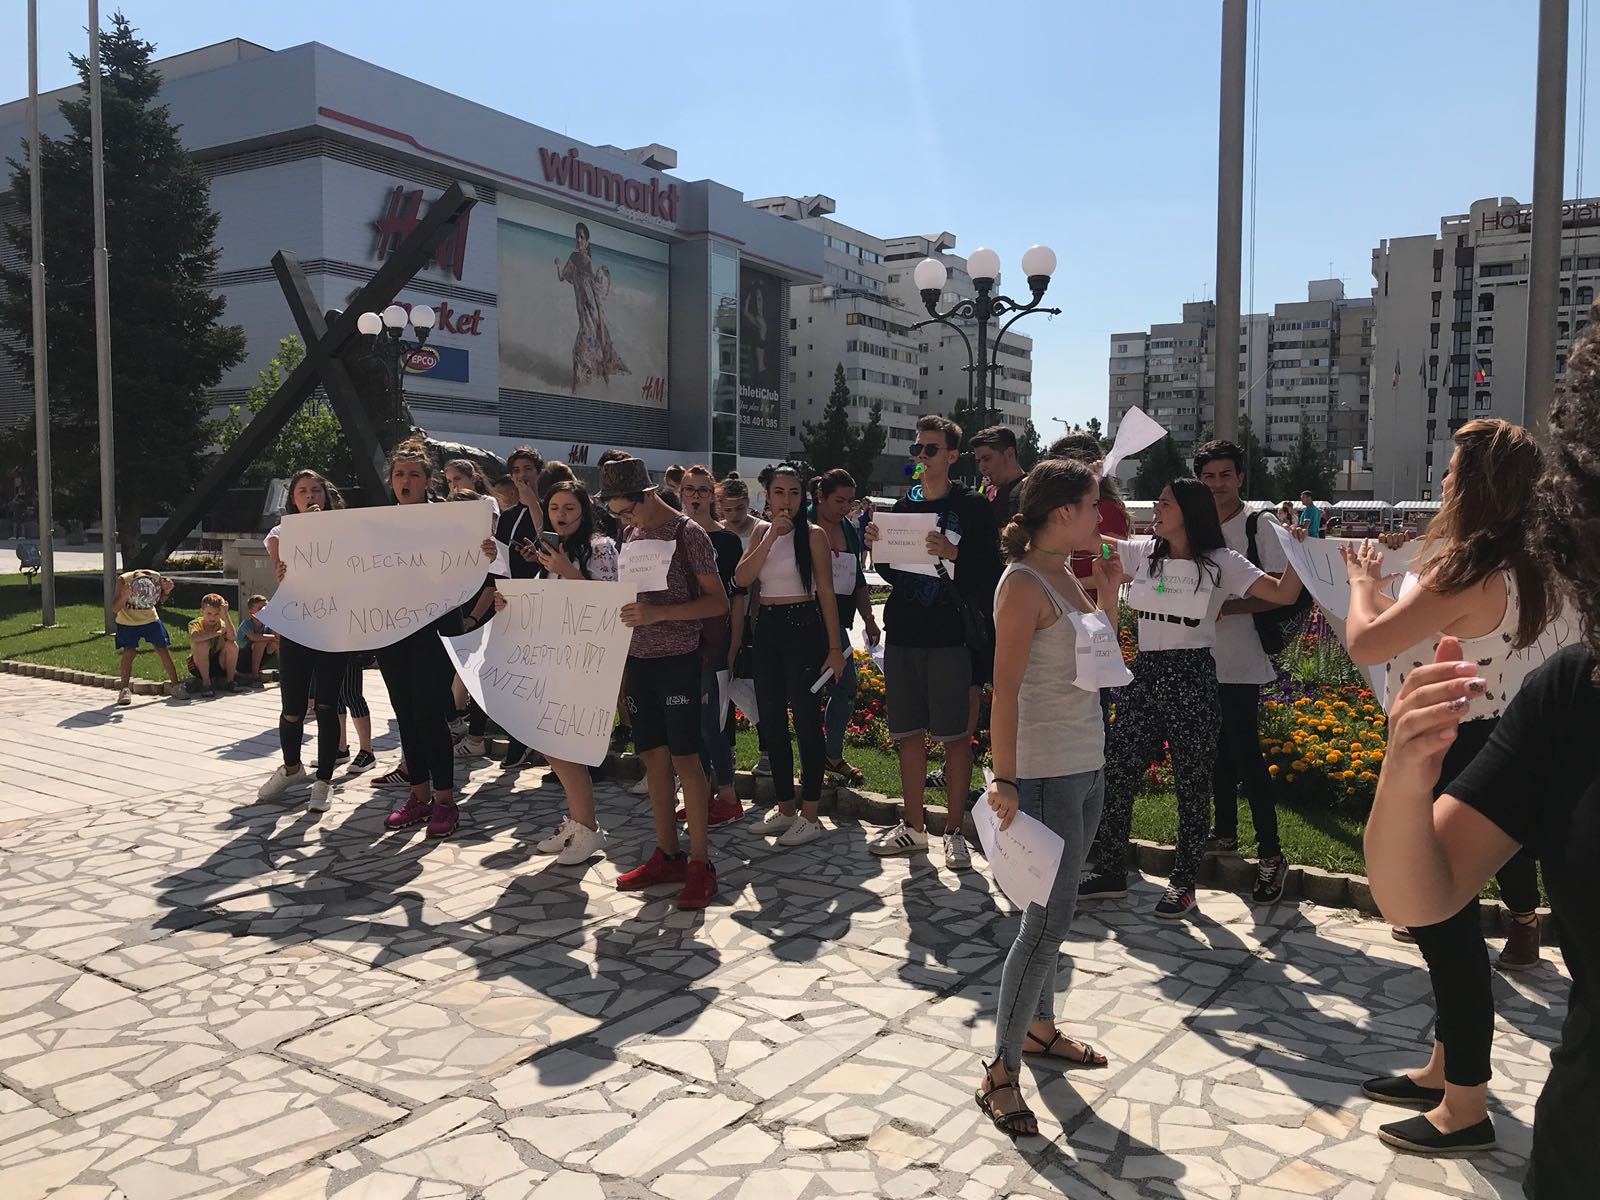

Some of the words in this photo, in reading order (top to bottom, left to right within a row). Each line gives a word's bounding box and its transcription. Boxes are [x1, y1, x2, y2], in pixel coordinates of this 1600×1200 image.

[538, 147, 679, 223] winmarkt
[1482, 209, 1532, 231] Hote
[568, 444, 589, 465] H&M
[293, 540, 333, 570] NU
[440, 550, 481, 574] DIN
[281, 596, 338, 622] CASA
[561, 597, 618, 635] AVEM
